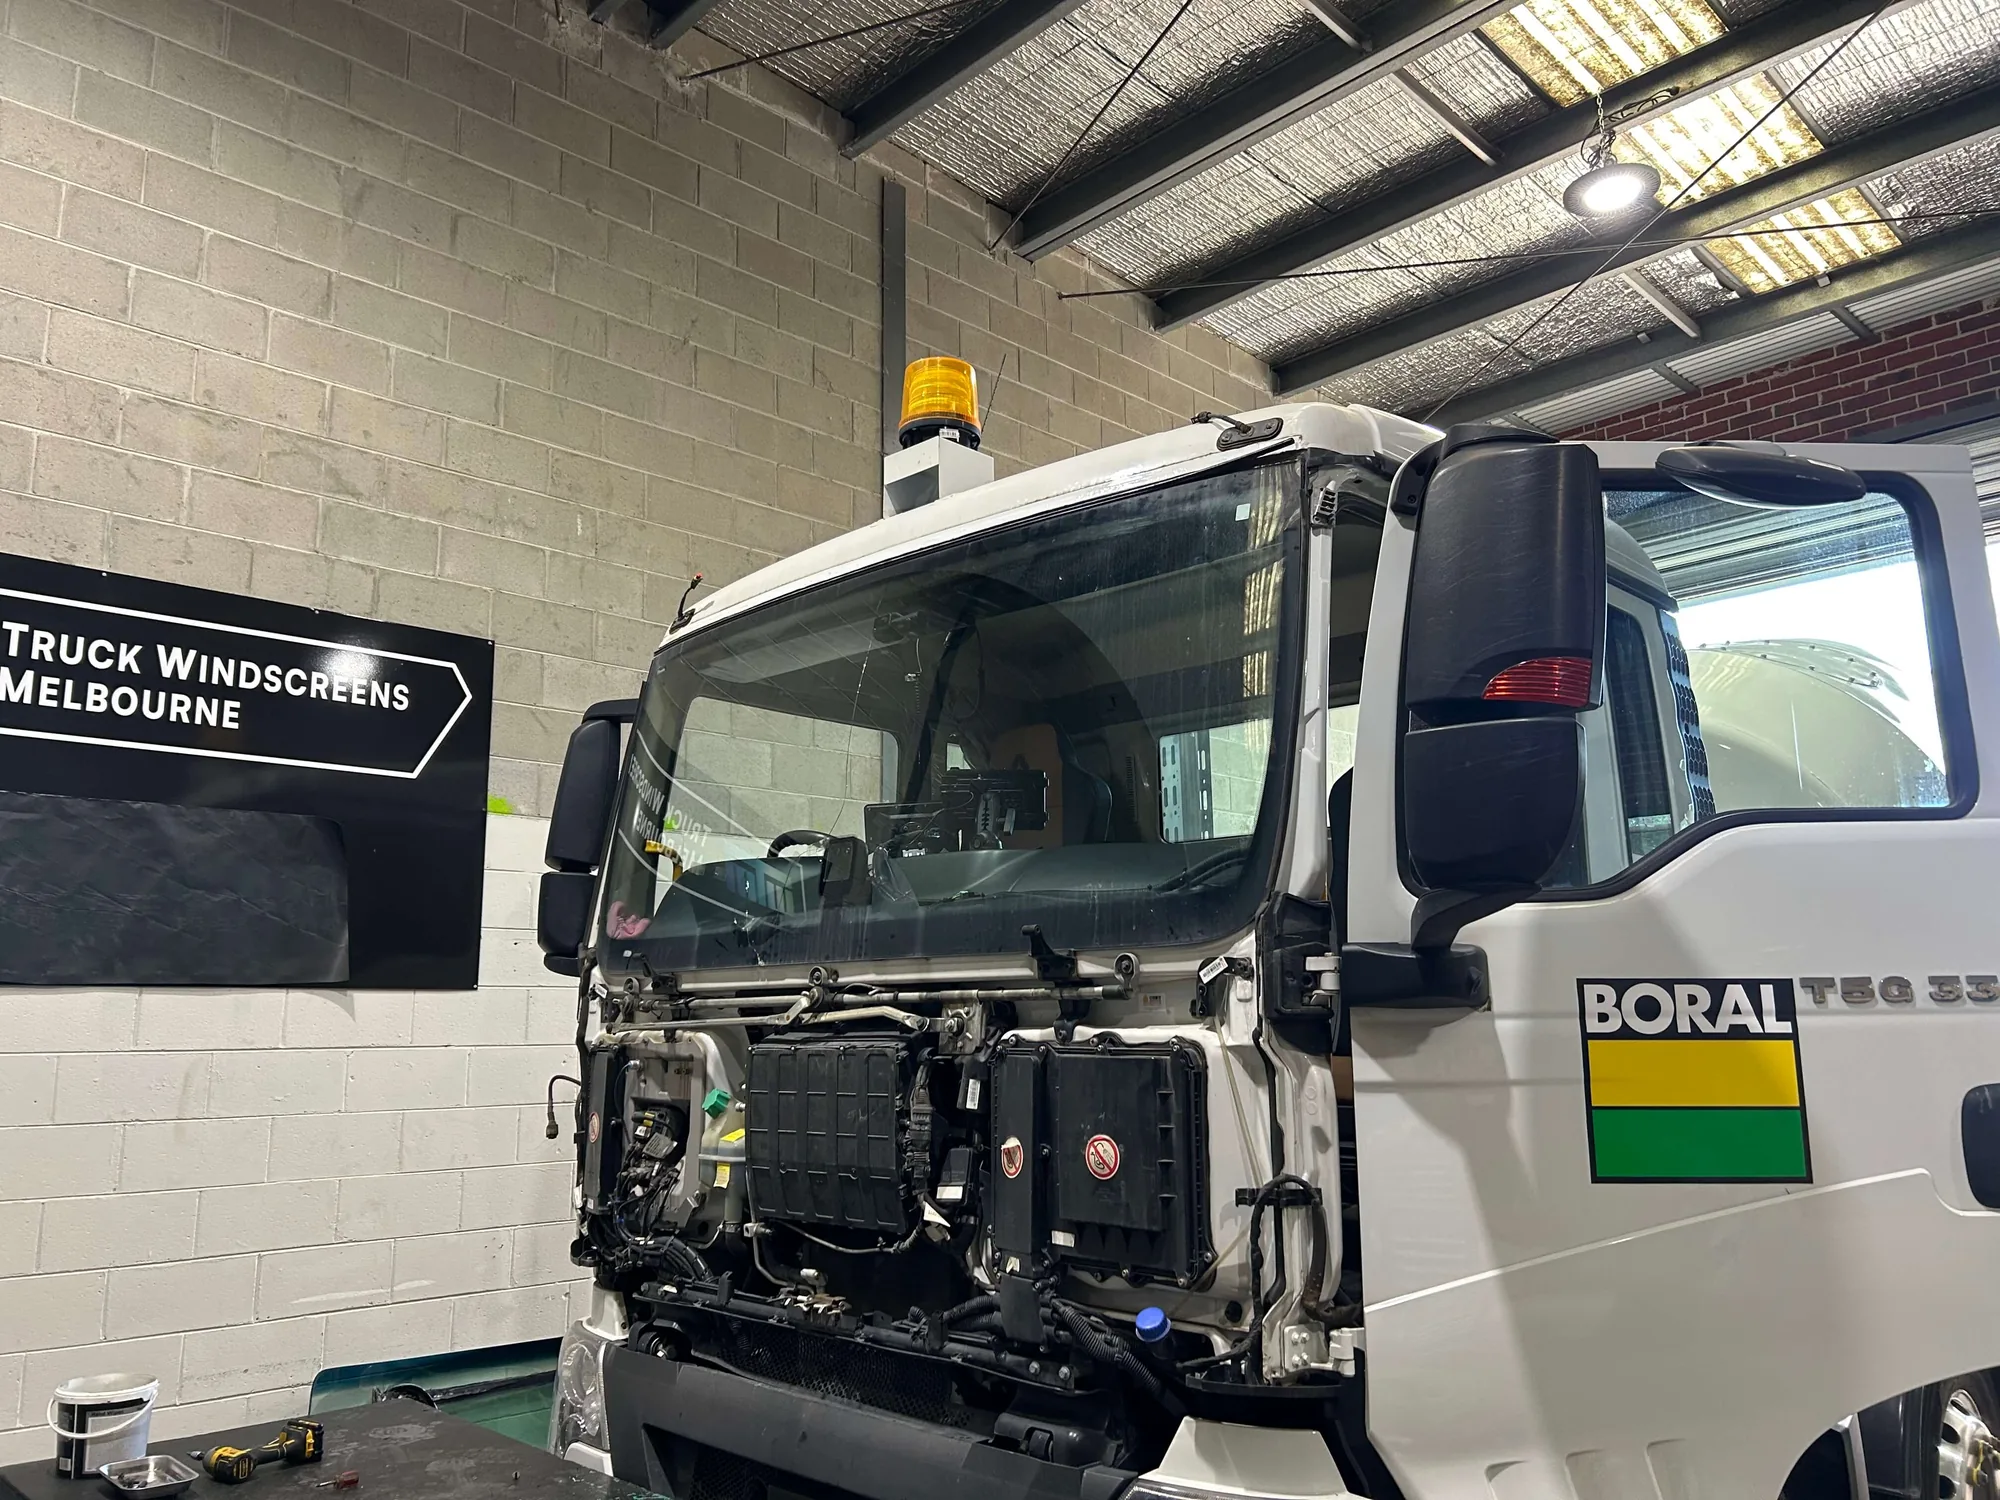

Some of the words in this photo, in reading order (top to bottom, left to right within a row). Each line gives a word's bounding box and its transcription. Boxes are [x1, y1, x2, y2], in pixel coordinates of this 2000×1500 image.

[2, 620, 142, 675] TRUCK
[156, 644, 410, 711] WINDSCREENS
[0, 666, 241, 729] MELBOURNE
[1583, 982, 1793, 1035] BORAL
